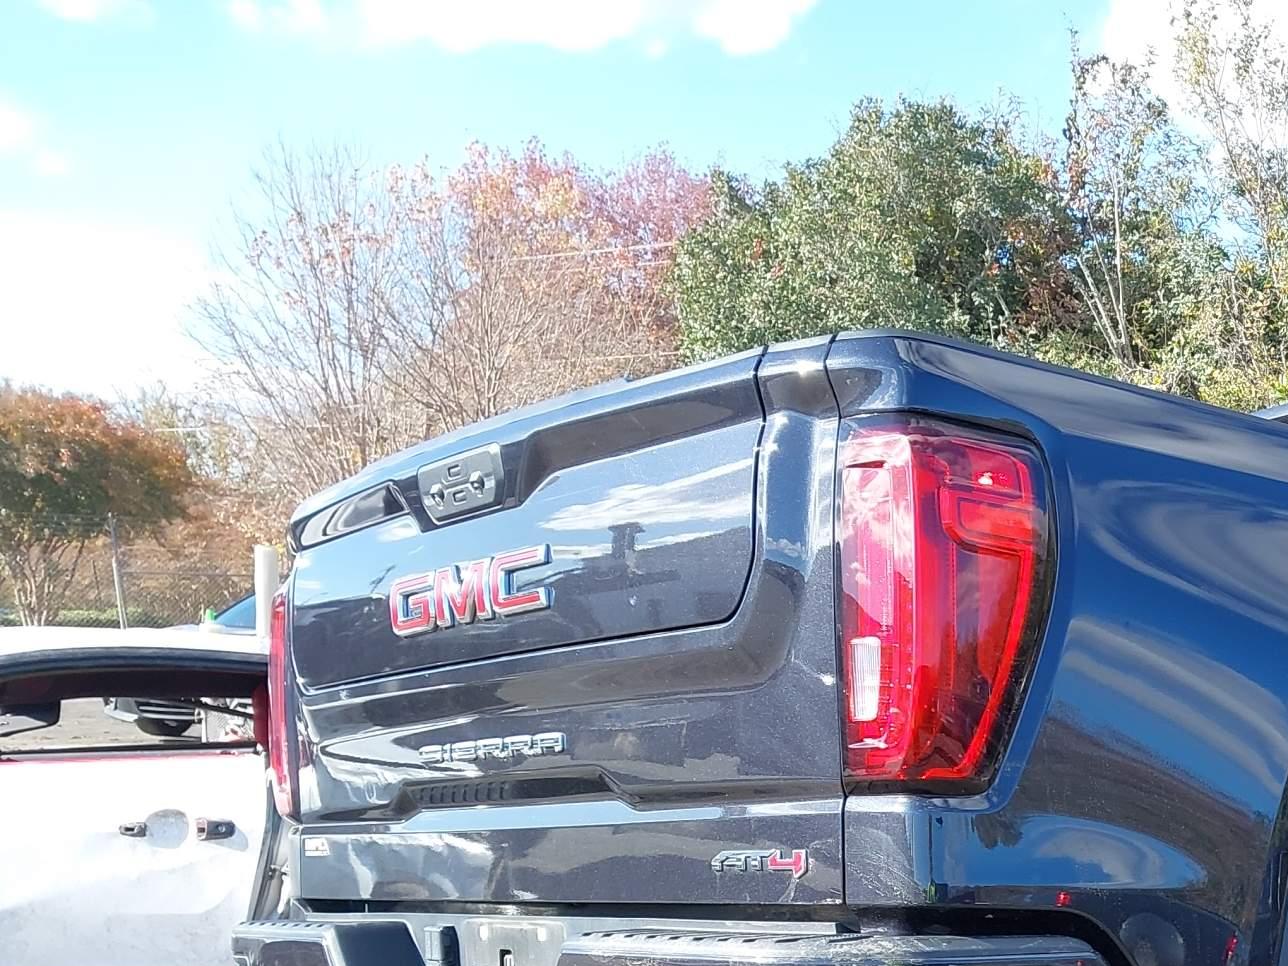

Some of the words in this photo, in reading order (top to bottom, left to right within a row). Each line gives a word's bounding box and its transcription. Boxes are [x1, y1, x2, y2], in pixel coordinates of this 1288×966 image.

[389, 543, 556, 638] GMC
[417, 732, 567, 763] SIERRA
[710, 848, 809, 880] AT4
